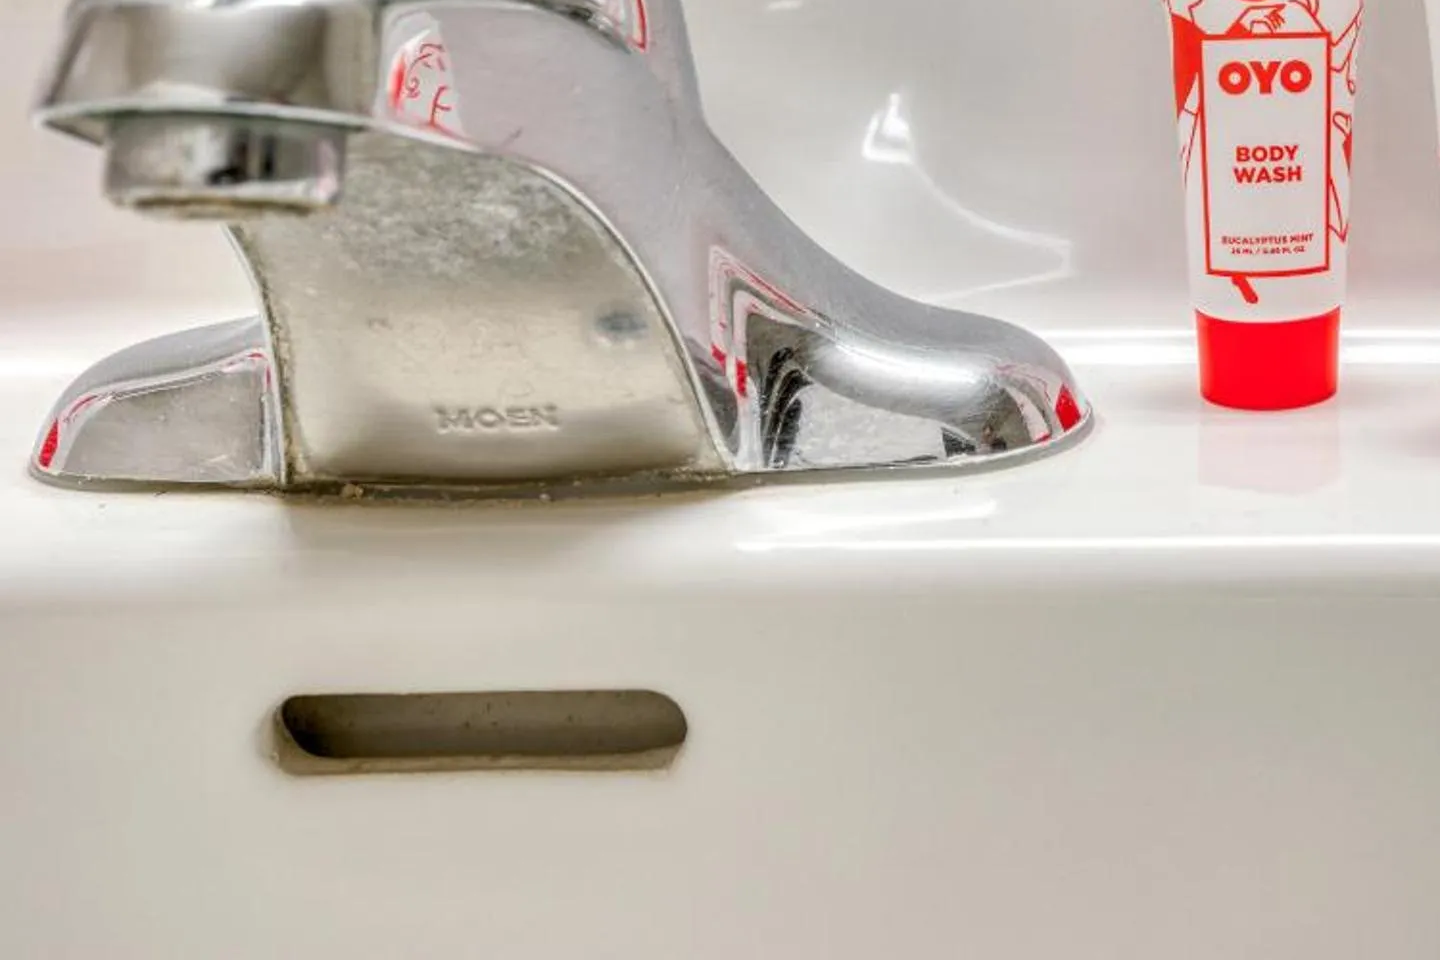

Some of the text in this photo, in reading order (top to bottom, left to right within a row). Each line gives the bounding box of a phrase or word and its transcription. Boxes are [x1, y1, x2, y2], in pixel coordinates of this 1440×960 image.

[1218, 60, 1313, 95] OYO
[1235, 145, 1299, 163] BODY
[1233, 166, 1302, 184] WASH
[1221, 232, 1314, 246] EUCALYPTUS MINT
[433, 404, 559, 434] MOEN
